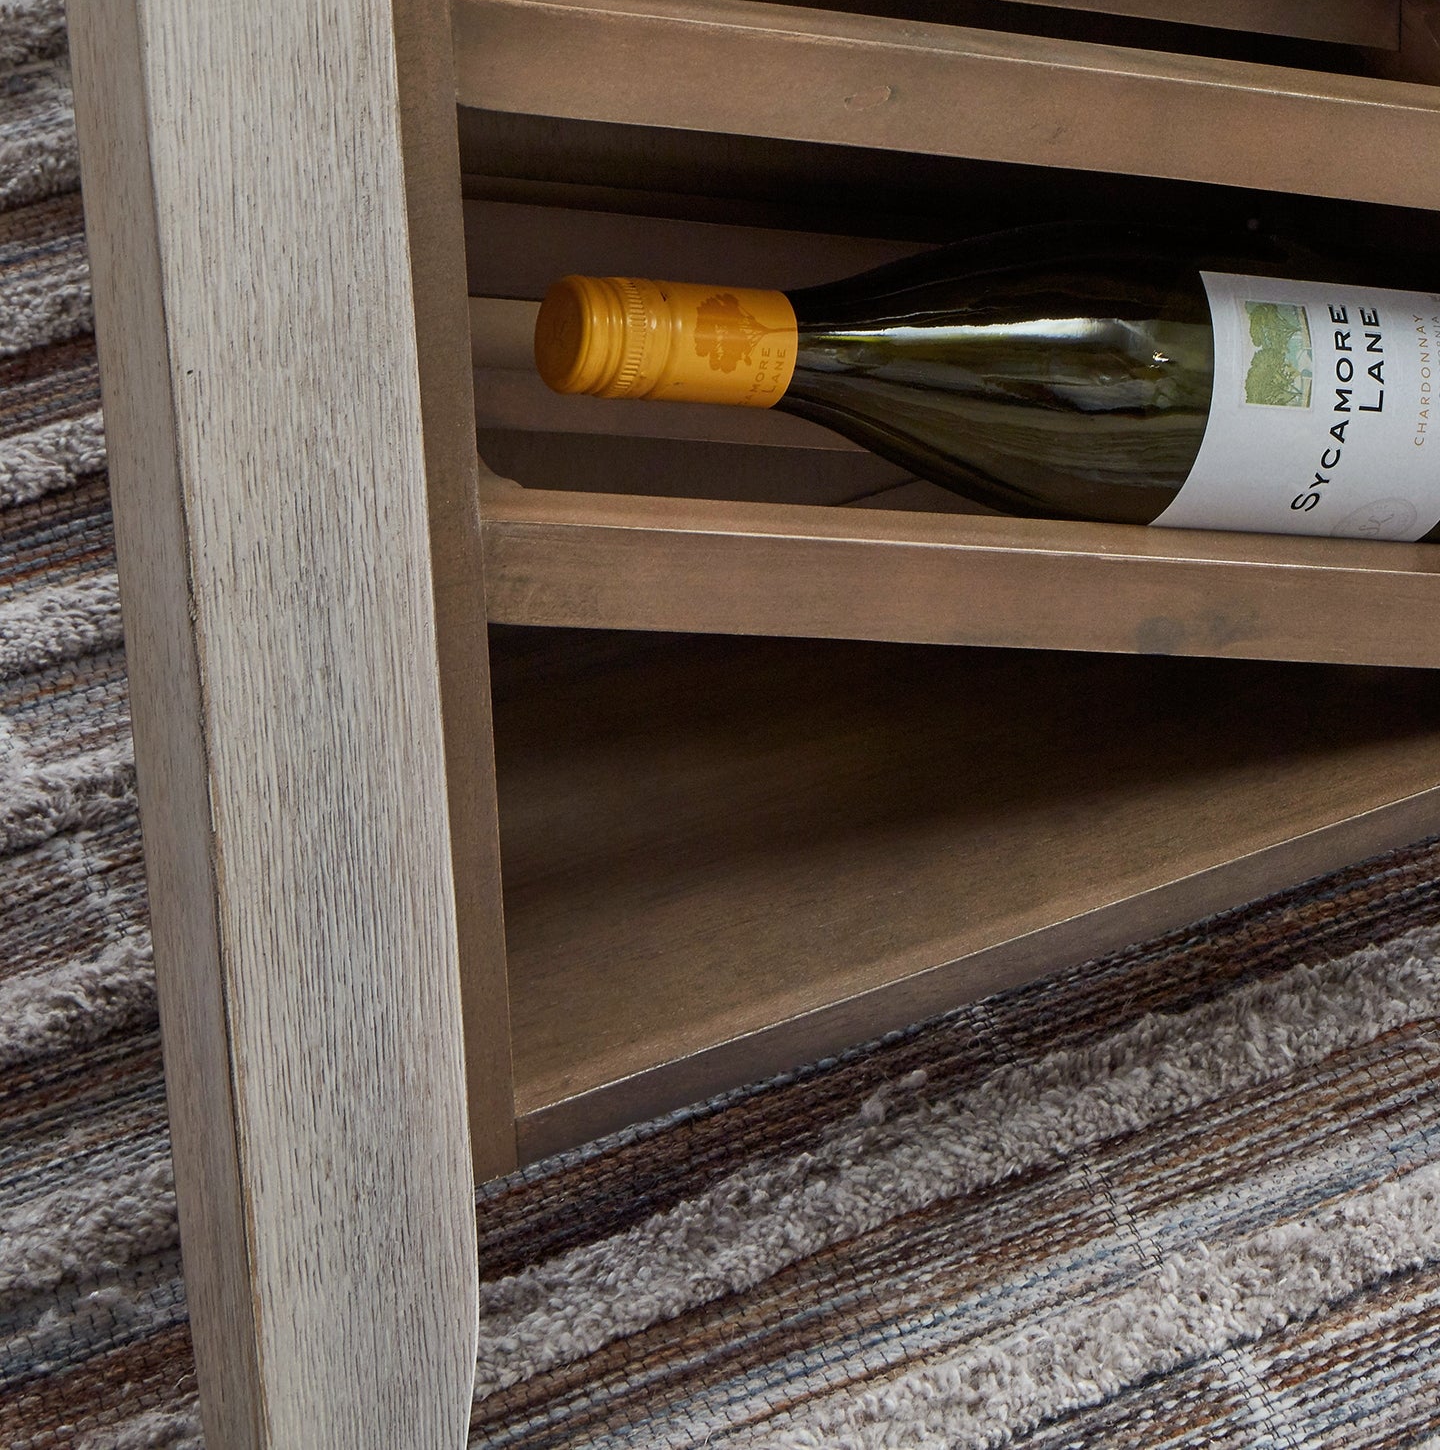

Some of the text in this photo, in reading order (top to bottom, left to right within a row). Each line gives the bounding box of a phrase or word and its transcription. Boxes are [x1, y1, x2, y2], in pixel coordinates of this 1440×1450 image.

[761, 349, 786, 393] LANE
[1290, 303, 1354, 512] SYCAMORE
[1359, 307, 1384, 413] LANE
[1413, 313, 1431, 447] CHARDONNAY
